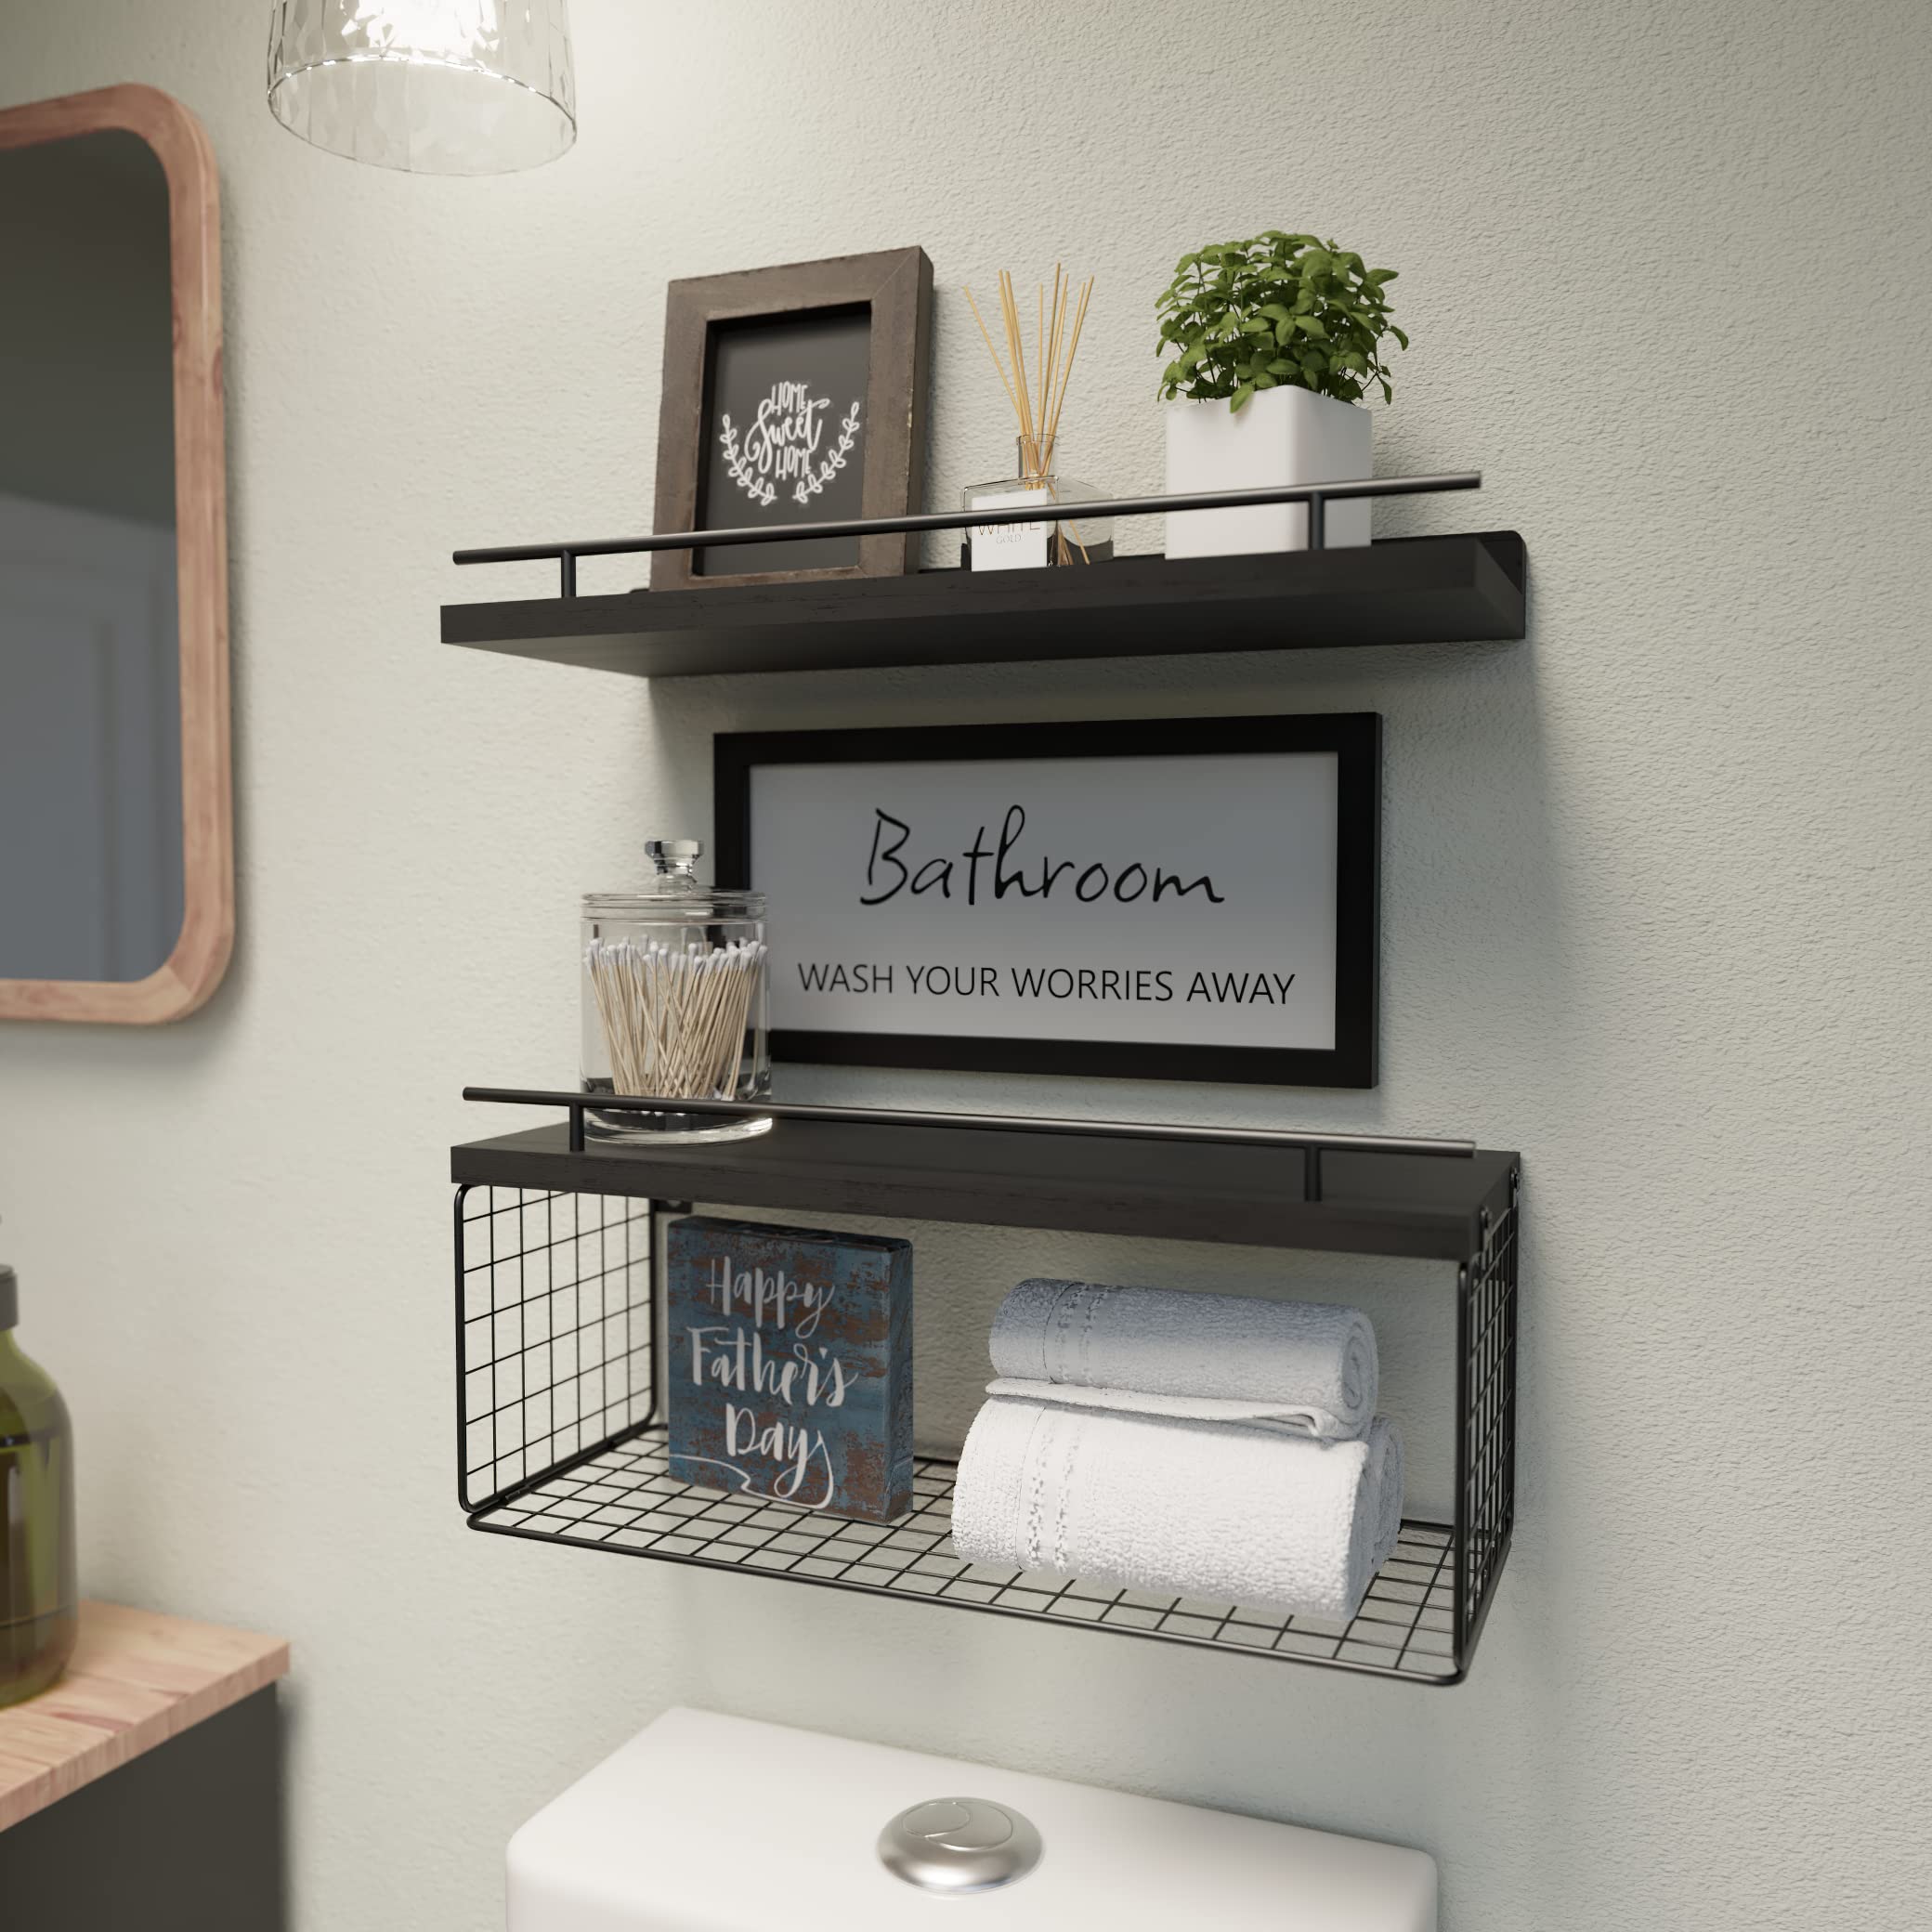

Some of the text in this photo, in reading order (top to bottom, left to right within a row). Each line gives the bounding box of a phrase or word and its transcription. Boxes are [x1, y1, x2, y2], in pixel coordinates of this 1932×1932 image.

[744, 398, 830, 474] Sweet
[770, 381, 808, 416] HOME
[775, 445, 812, 481] HOME
[996, 534, 1022, 544] GOLD
[860, 804, 1225, 906] Bathroom
[797, 963, 1296, 1005] WASH YOUR WORRIES AWAY
[706, 1256, 835, 1338] Happy
[686, 1326, 859, 1407] Father's
[725, 1403, 833, 1499] Day
